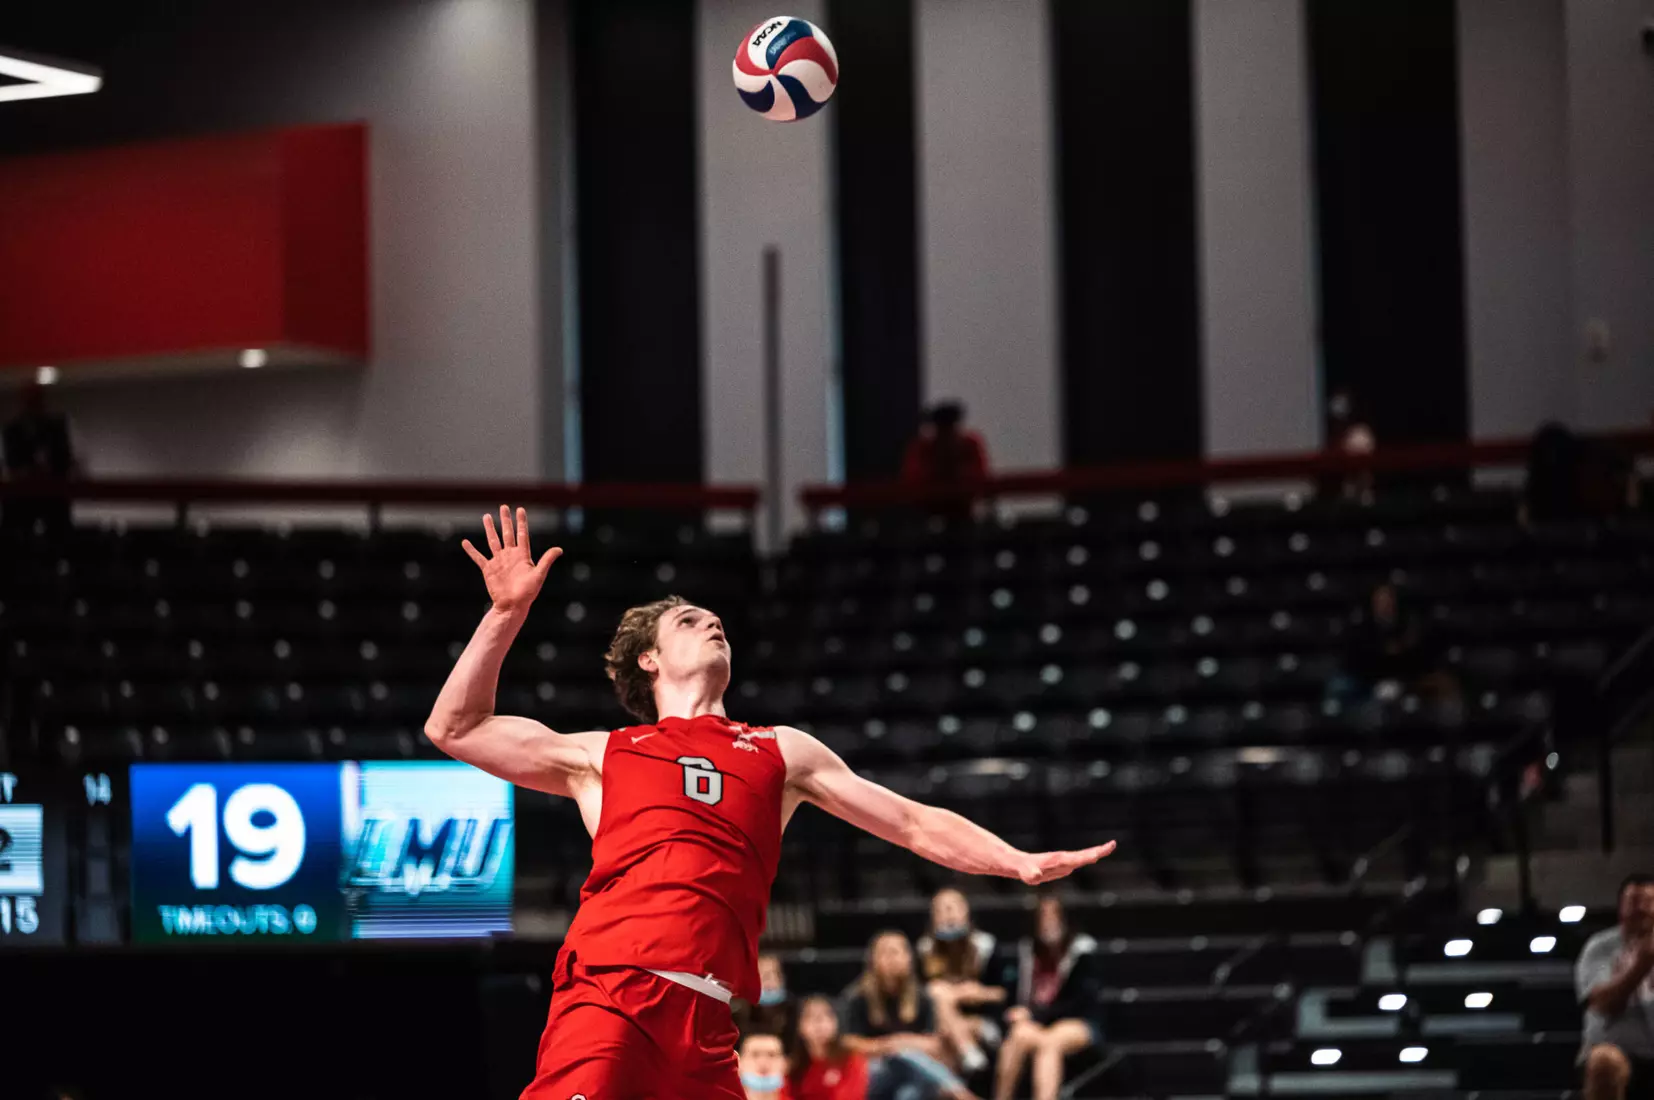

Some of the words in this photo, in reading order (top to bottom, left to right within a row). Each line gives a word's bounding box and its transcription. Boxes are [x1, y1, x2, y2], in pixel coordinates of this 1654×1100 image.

[752, 20, 783, 47] NCAA
[677, 755, 724, 806] 6
[164, 782, 307, 890] 19
